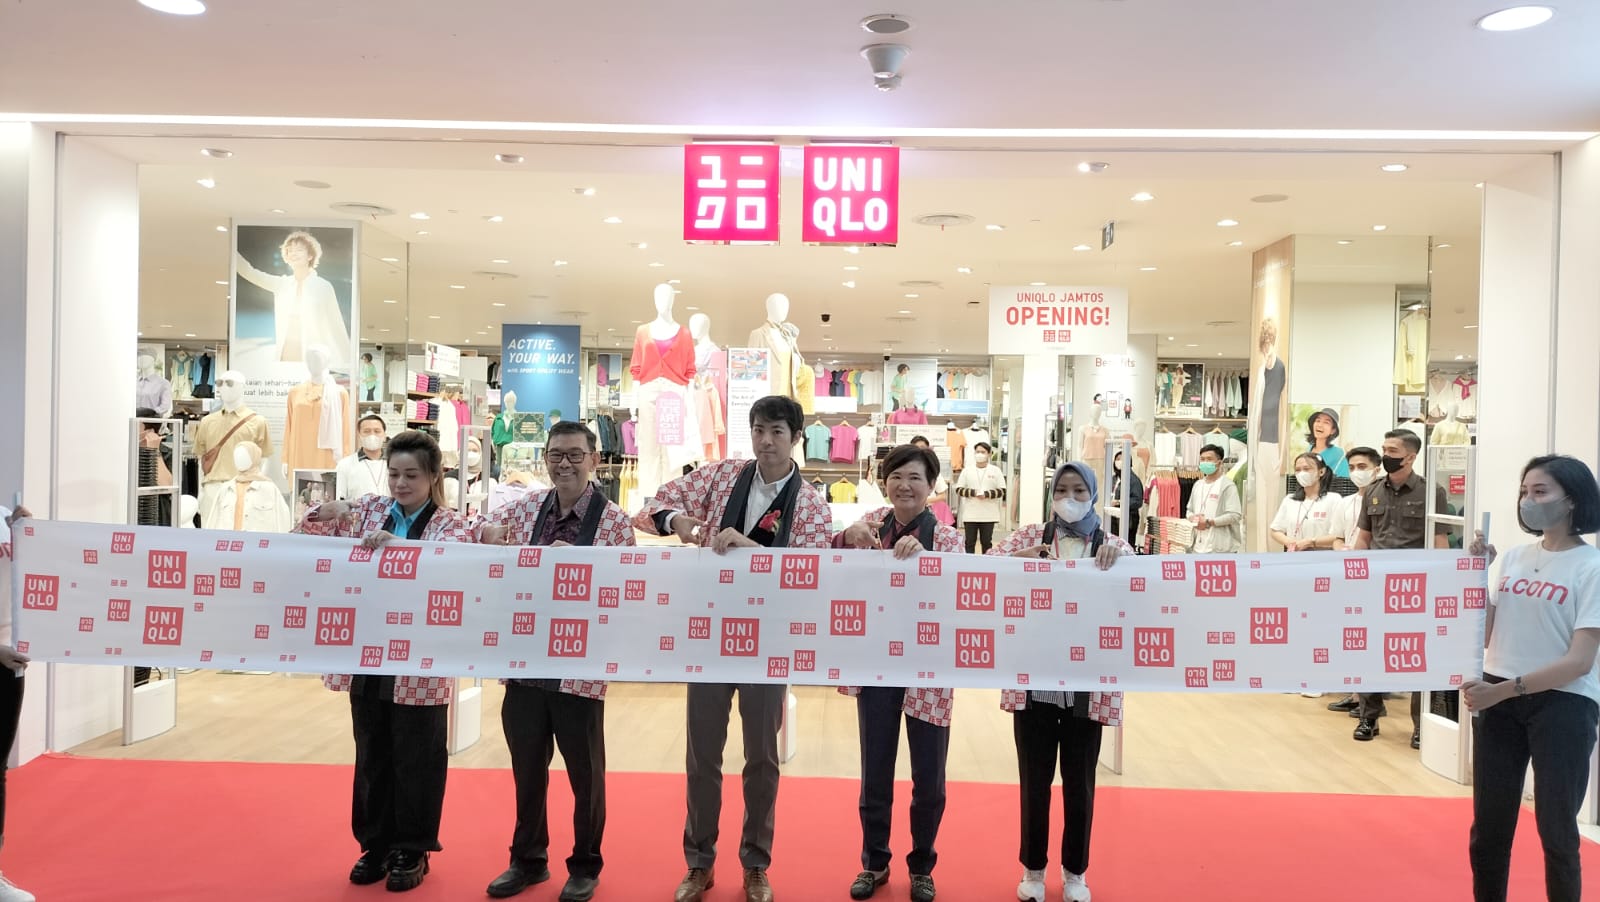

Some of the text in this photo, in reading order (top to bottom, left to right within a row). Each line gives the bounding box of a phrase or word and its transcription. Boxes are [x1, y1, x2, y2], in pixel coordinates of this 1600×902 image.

[697, 155, 766, 188] ユニ
[814, 157, 882, 191] UNI
[694, 196, 766, 229] クロ
[813, 197, 888, 236] QLO
[1017, 292, 1104, 304] UNIQLO JAMTOS
[1006, 306, 1110, 326] OPENING!
[507, 338, 557, 351] ACTIVE.
[509, 352, 575, 365] YOUR WAY.
[116, 534, 131, 543] UNI
[115, 543, 131, 552] QLO
[352, 550, 369, 559] QLO
[386, 551, 414, 560] UNI
[153, 555, 180, 568] UNI
[786, 558, 812, 570] UNI
[223, 570, 237, 578] UNI
[383, 561, 412, 576] QLO
[558, 568, 585, 581] UNI
[922, 566, 938, 574] QLO
[1200, 564, 1229, 576] UNI
[1348, 569, 1365, 577] QLO
[152, 570, 182, 585] QLO
[222, 578, 238, 586] QLO
[785, 572, 814, 586] QLO
[961, 576, 988, 590] UNI
[28, 578, 53, 592] UNI
[557, 583, 586, 597] QLO
[627, 582, 642, 590] UNI
[1200, 579, 1232, 593] QLO
[1390, 578, 1419, 592] UNI
[27, 593, 54, 607] QLO
[961, 592, 991, 607] QLO
[1465, 590, 1483, 598] UNI
[111, 602, 127, 610] UNI
[432, 595, 457, 608] UNI
[1389, 594, 1421, 610] QLO
[1466, 599, 1483, 607] QLO
[110, 611, 127, 619] QLO
[288, 608, 303, 617] UNI
[431, 609, 458, 622] QLO
[835, 604, 859, 617] UNI
[149, 611, 176, 625] UNI
[322, 612, 348, 625] UNI
[516, 615, 531, 623] UNI
[691, 619, 706, 628] UNI
[1255, 612, 1281, 624] UNI
[554, 624, 581, 637] UNI
[691, 628, 708, 637] QLO
[726, 623, 752, 636] UNI
[834, 619, 862, 634] QLO
[920, 625, 935, 633] UNI
[1102, 629, 1118, 637] UNI
[148, 627, 178, 641] QLO
[320, 627, 350, 642] QLO
[920, 634, 937, 642] QLO
[1139, 632, 1167, 646] UNI
[1254, 627, 1284, 642] QLO
[1347, 630, 1363, 638] UNI
[391, 642, 406, 650] UNI
[553, 639, 582, 654] QLO
[725, 638, 754, 653] QLO
[960, 634, 987, 648] UNI
[1102, 638, 1120, 647] QLO
[1346, 640, 1364, 648] QLO
[1389, 637, 1418, 651] UNI
[960, 649, 990, 666] QLO
[1139, 648, 1170, 663] QLO
[1389, 654, 1421, 670] QLO
[796, 661, 813, 669] QLO
[1216, 662, 1231, 670] UNI
